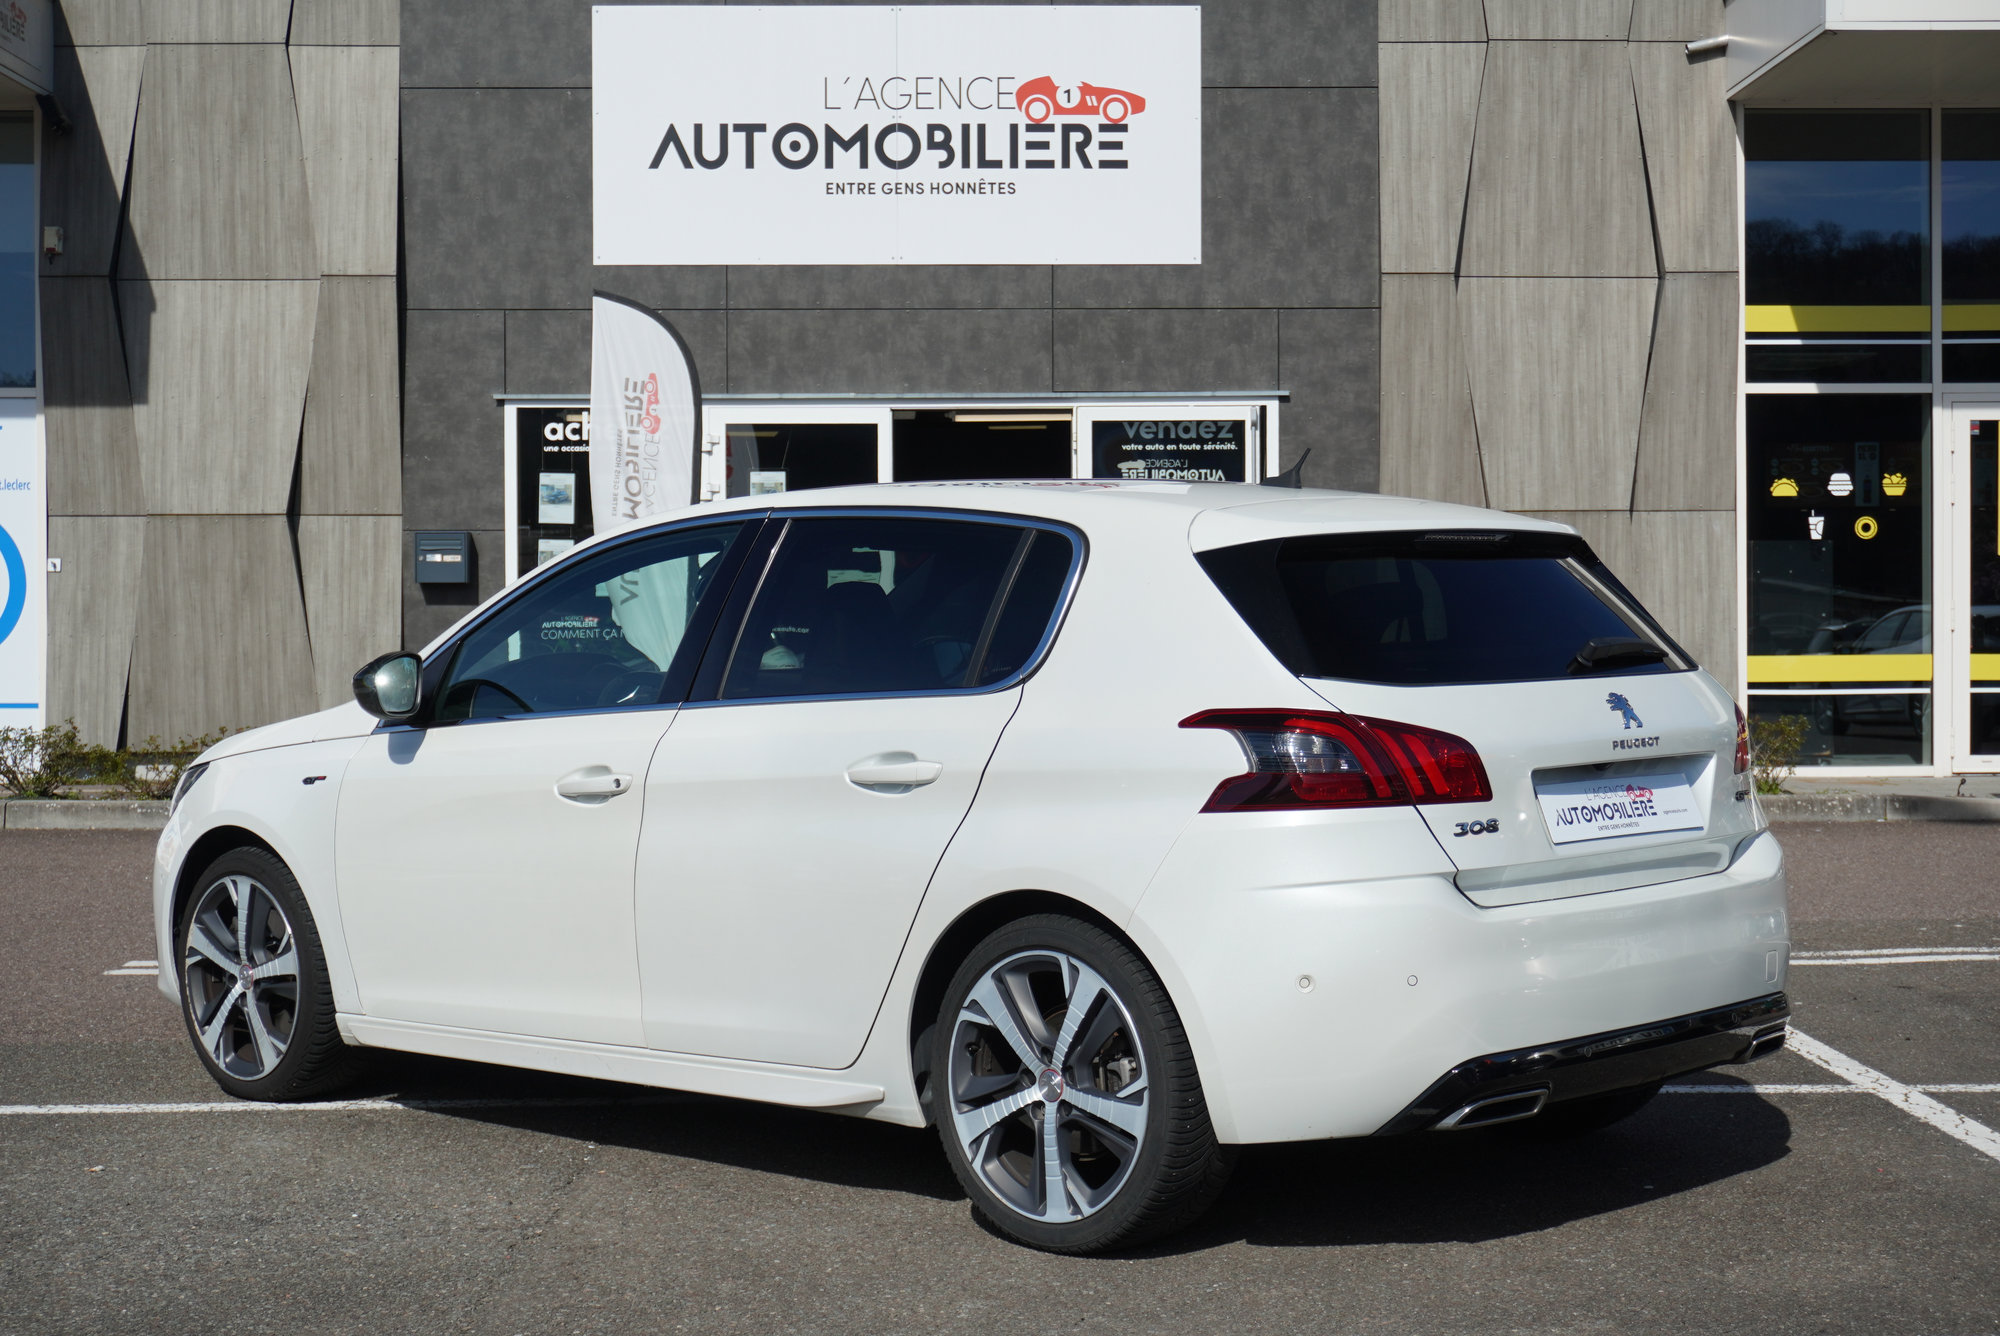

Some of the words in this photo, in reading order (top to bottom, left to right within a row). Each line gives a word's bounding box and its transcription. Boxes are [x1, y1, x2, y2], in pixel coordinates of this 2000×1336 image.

[824, 76, 1016, 111] L'AGENCE
[648, 122, 1129, 170] AUTOMOBILIERE
[825, 181, 876, 195] ENTRE
[881, 181, 925, 195] GENS
[930, 177, 1016, 195] HONNÊTES
[543, 411, 590, 441] ach
[1123, 421, 1233, 439] vendez
[543, 444, 560, 453] une
[560, 443, 590, 453] occasio
[1121, 443, 1144, 451] votre
[1145, 443, 1165, 451] auto
[1178, 443, 1202, 451] toute
[1203, 442, 1239, 451] sérénité.
[540, 628, 601, 640] COMMENT
[602, 627, 618, 641] ÇA
[1612, 736, 1661, 751] PEUGEOT
[1584, 784, 1627, 801] L'AGENCE
[1556, 800, 1657, 826] AUTOMOBILIERE
[1453, 818, 1500, 838] 308
